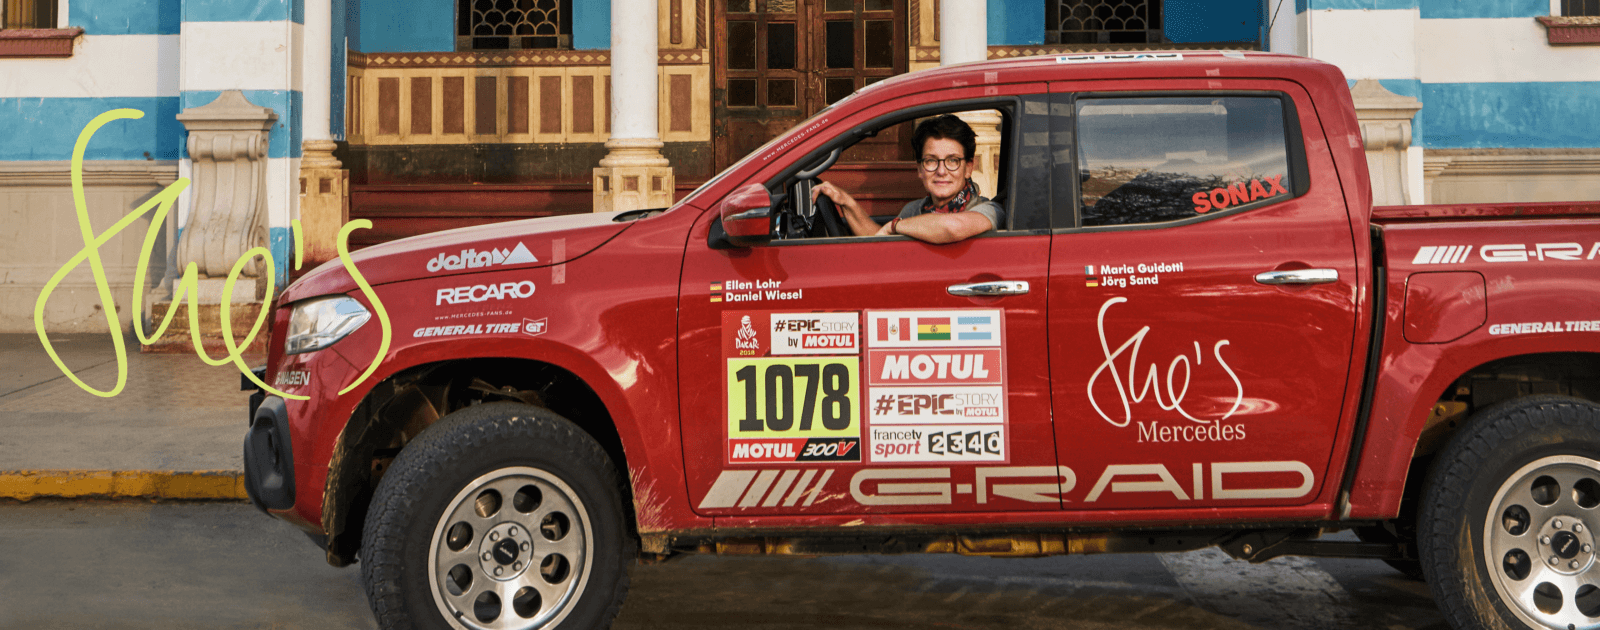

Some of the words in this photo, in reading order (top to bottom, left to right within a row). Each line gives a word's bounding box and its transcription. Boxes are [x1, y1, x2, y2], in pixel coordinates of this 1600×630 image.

[1192, 173, 1289, 214] SONAX
[1479, 241, 1600, 263] G-R
[1100, 264, 1134, 275] Maria
[1137, 262, 1184, 274] Guidotti
[725, 280, 753, 291] Ellen
[756, 278, 782, 290] Lohr
[1101, 276, 1127, 288] Jörg
[1129, 274, 1159, 286] Sand
[435, 280, 536, 306] RECARO
[725, 291, 763, 302] Daniel
[765, 289, 803, 301] Wiesel
[434, 310, 513, 321] www.MERCEDES-FANS.de
[413, 323, 483, 338] GENERAL
[485, 322, 522, 334] TIRE
[525, 322, 545, 333] GT
[1488, 321, 1564, 335] GENERAL
[1564, 320, 1600, 333] TIRE
[788, 336, 799, 348] by
[804, 335, 853, 348] MOTUL
[880, 353, 990, 381] MOTUL
[736, 363, 851, 432] 1078
[965, 407, 998, 417] MOTUL
[1136, 420, 1246, 443] Mercedes
[732, 443, 796, 459] MOTUL
[802, 441, 857, 457] 300V
[874, 440, 922, 458] sport
[849, 460, 1315, 506] G-RAID
